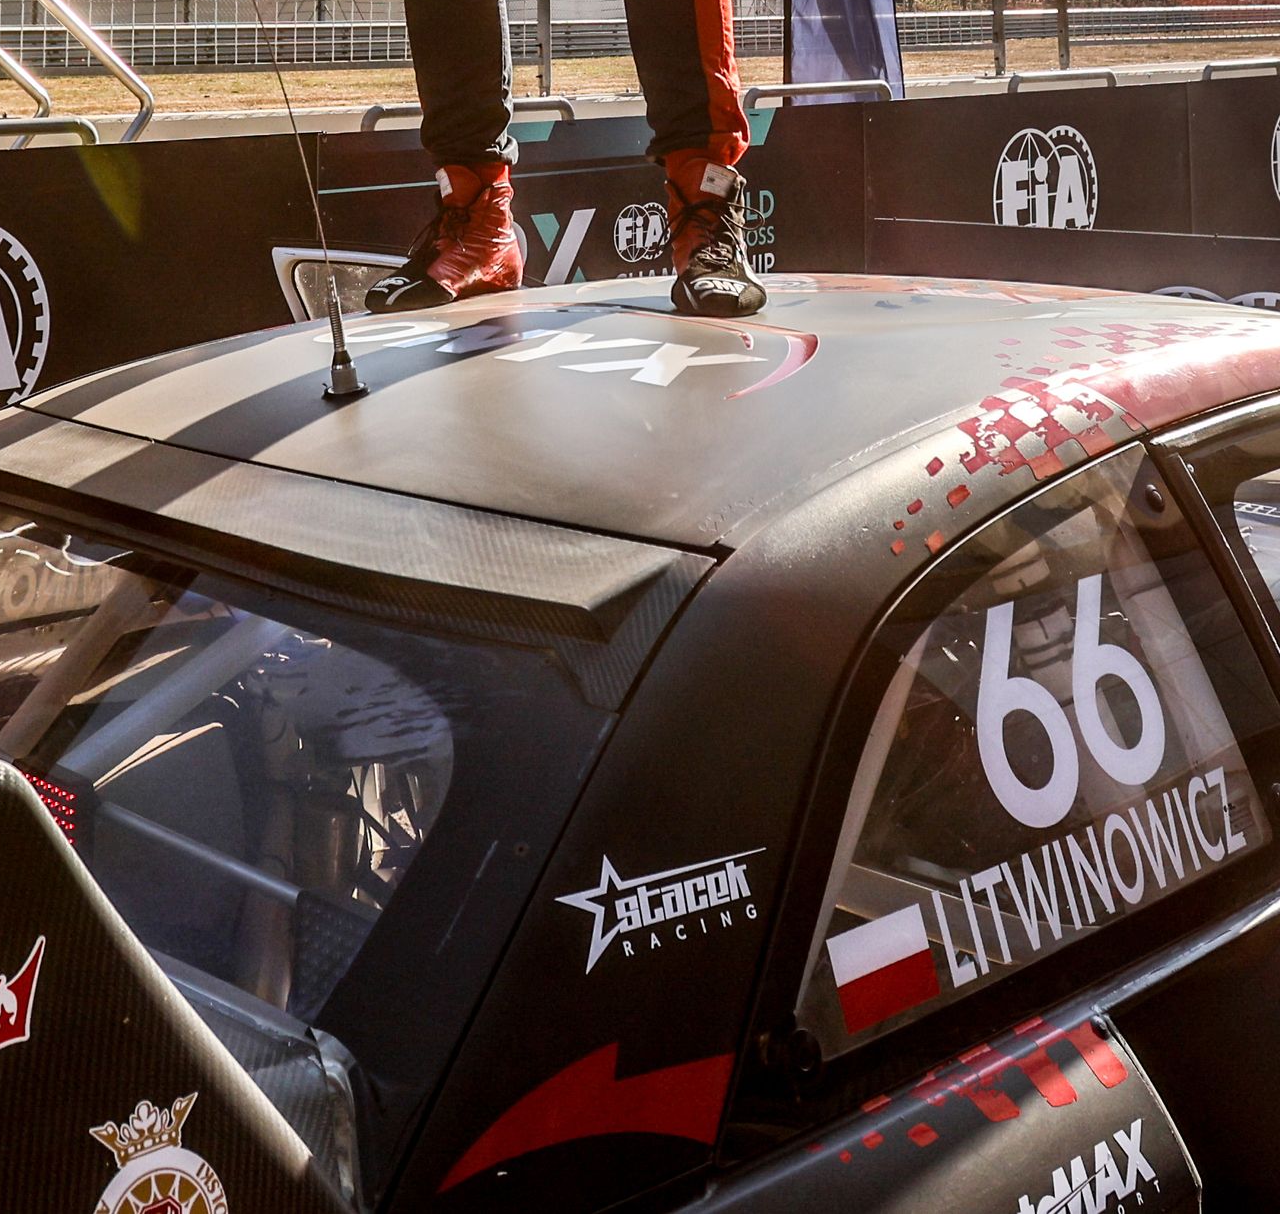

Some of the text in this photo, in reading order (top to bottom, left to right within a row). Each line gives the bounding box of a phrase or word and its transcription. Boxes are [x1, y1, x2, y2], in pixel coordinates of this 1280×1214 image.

[976, 573, 1166, 829] 66
[623, 903, 758, 957] RACING
[932, 765, 1248, 988] LITWINOWICZ
